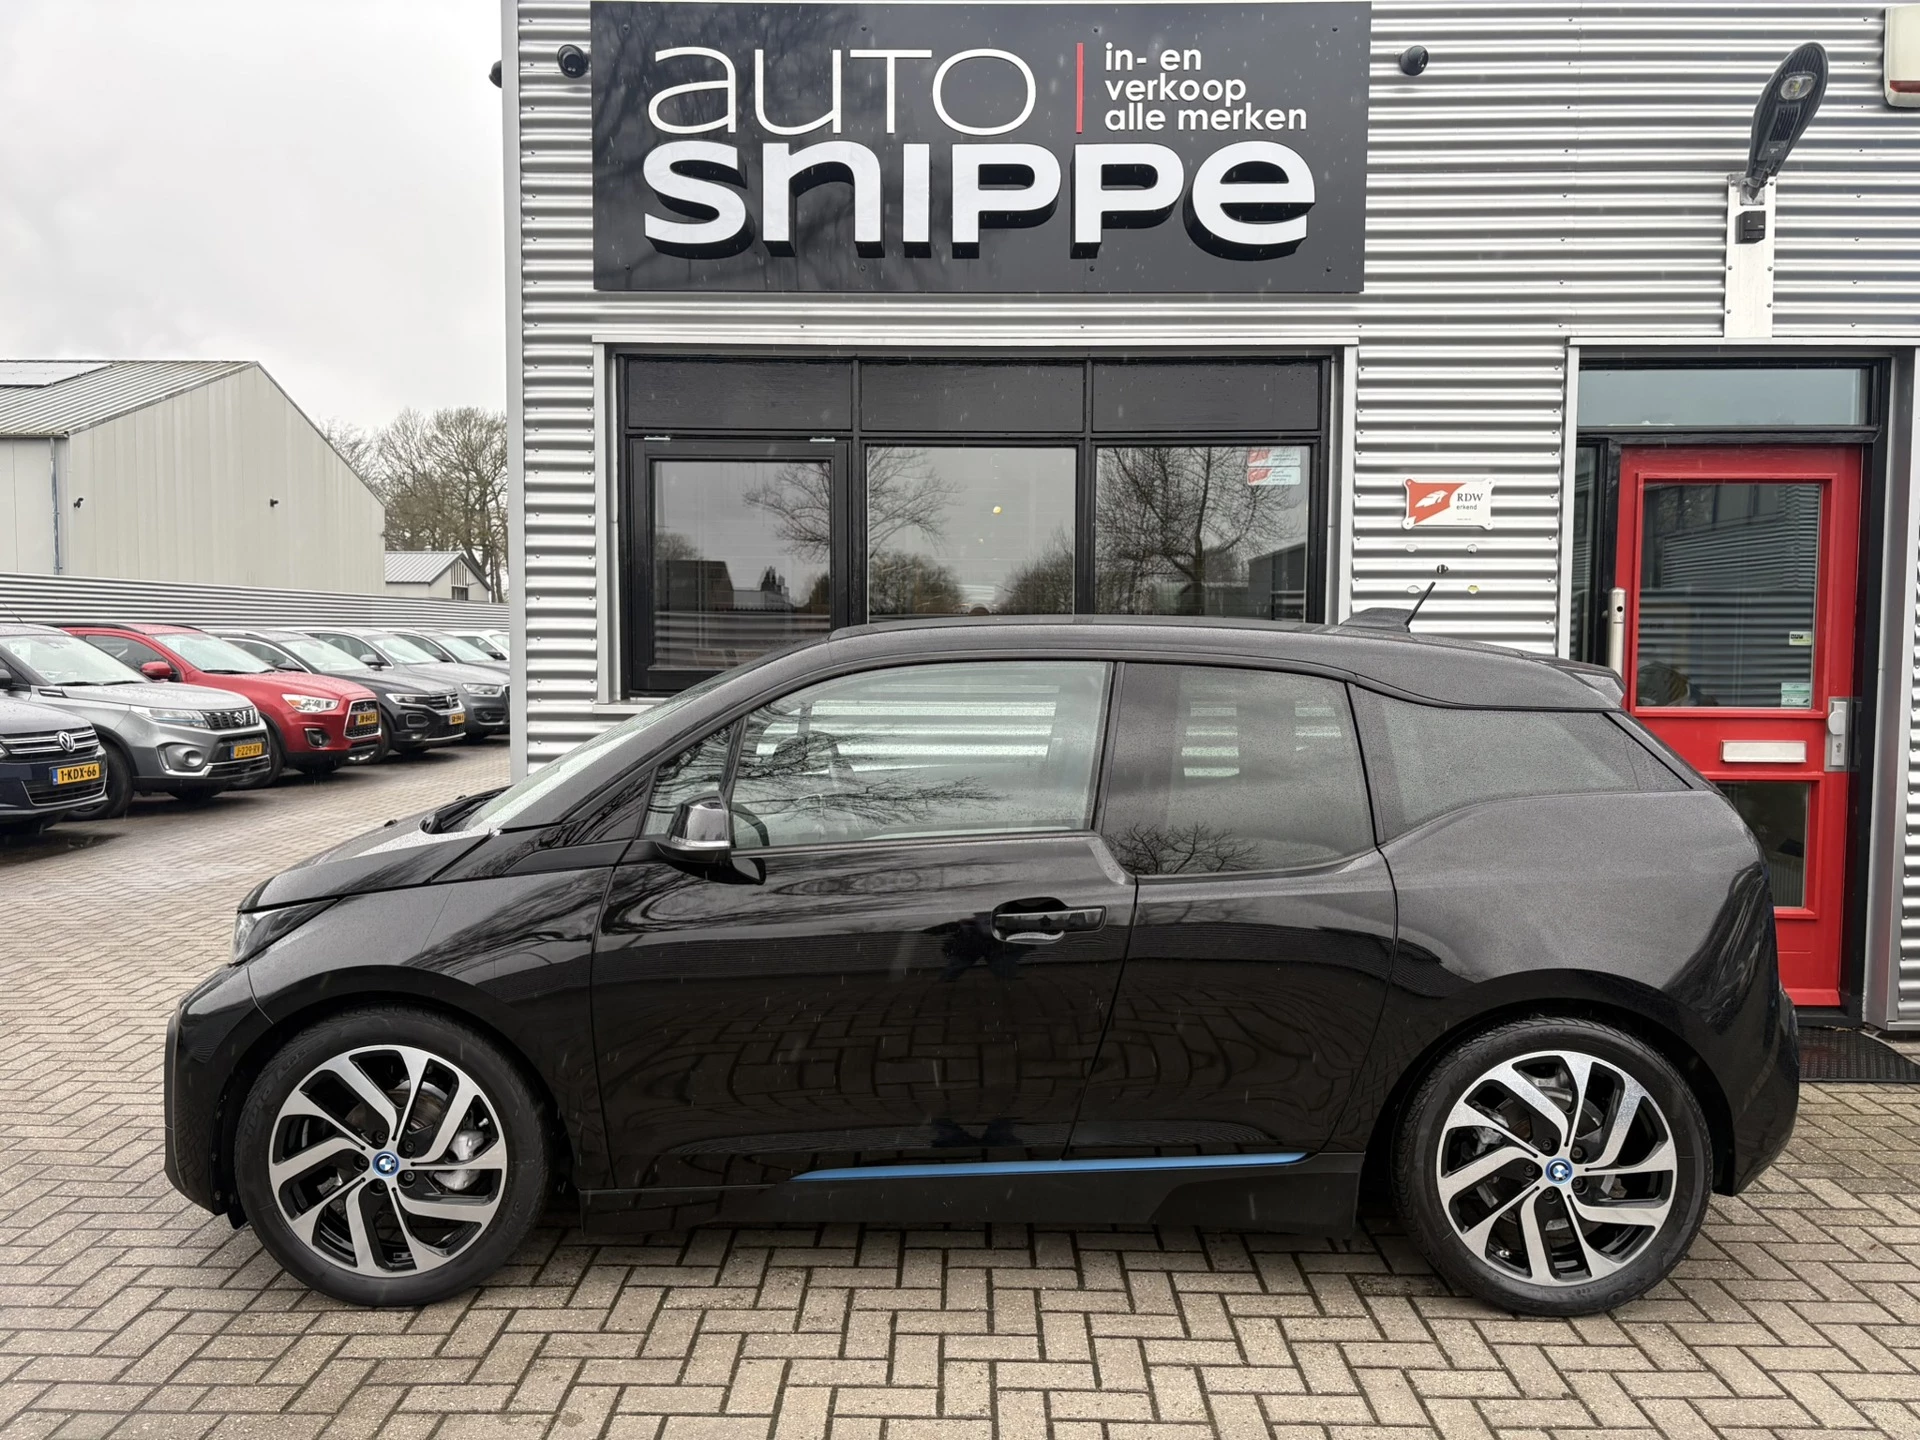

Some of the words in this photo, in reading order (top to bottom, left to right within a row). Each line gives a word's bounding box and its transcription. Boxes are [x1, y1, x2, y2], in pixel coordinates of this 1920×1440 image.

[1105, 42, 1147, 71] in-
[1160, 49, 1202, 71] en
[1104, 73, 1247, 107] verkoop
[1104, 102, 1166, 131] alle
[1178, 102, 1307, 131] merken
[1457, 493, 1484, 502] RDW
[60, 765, 97, 782] 1-KDX-66
